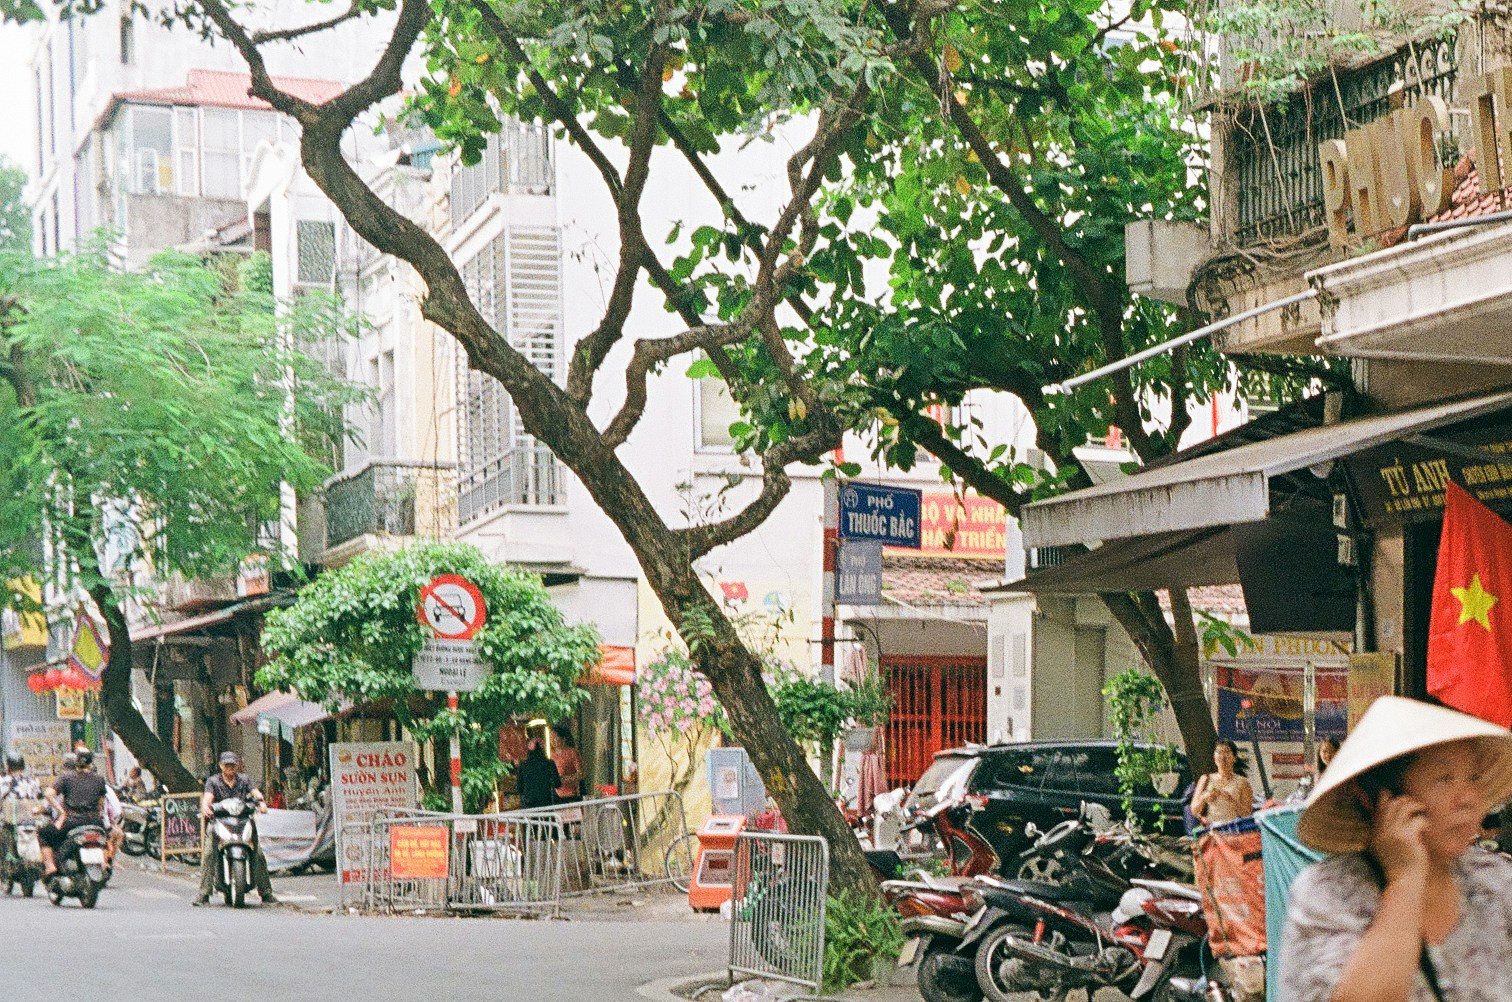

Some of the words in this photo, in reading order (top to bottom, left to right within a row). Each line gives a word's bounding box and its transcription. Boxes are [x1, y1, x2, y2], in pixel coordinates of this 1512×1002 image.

[1380, 456, 1410, 497] TÚ
[1412, 458, 1452, 493] ANH
[867, 492, 895, 509] PHỐ
[848, 508, 887, 537] THUỐC
[356, 749, 407, 768] CHÁO
[341, 770, 377, 785] SƯỜN
[380, 771, 407, 786] SỤN
